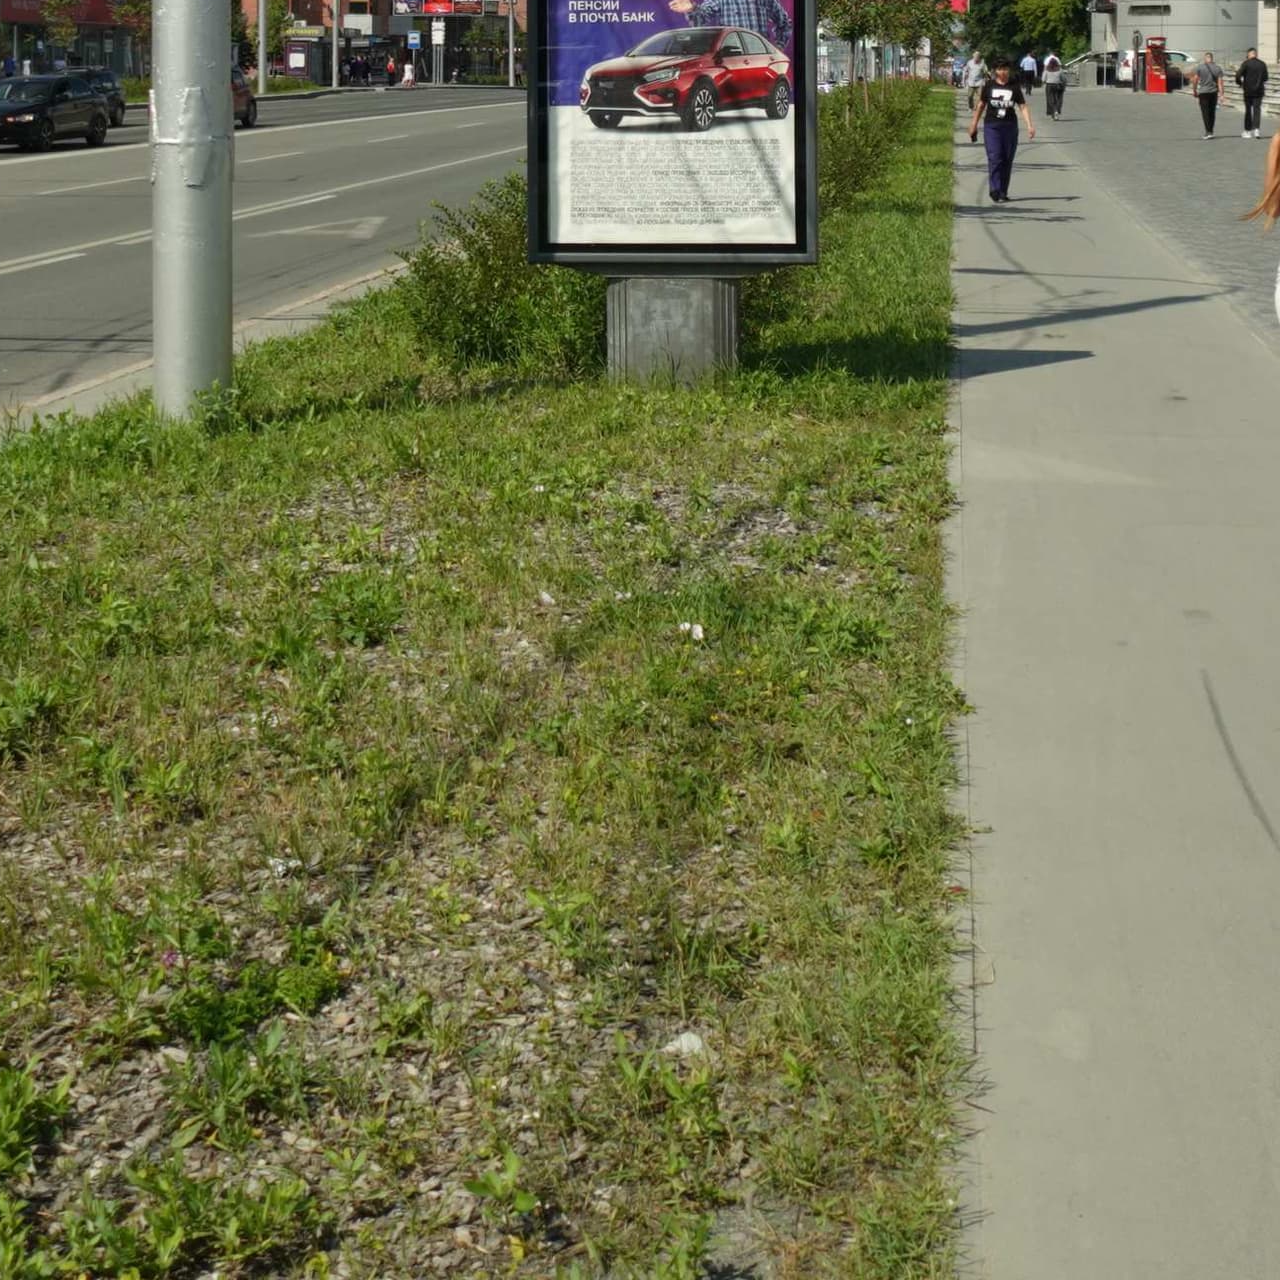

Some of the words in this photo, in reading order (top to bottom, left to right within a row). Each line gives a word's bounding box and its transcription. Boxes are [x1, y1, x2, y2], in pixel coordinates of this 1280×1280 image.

[568, 0, 620, 11] ПЕНСИИ
[568, 13, 577, 22] В
[580, 12, 620, 23] ПОЧТА
[622, 12, 655, 22] БАНК
